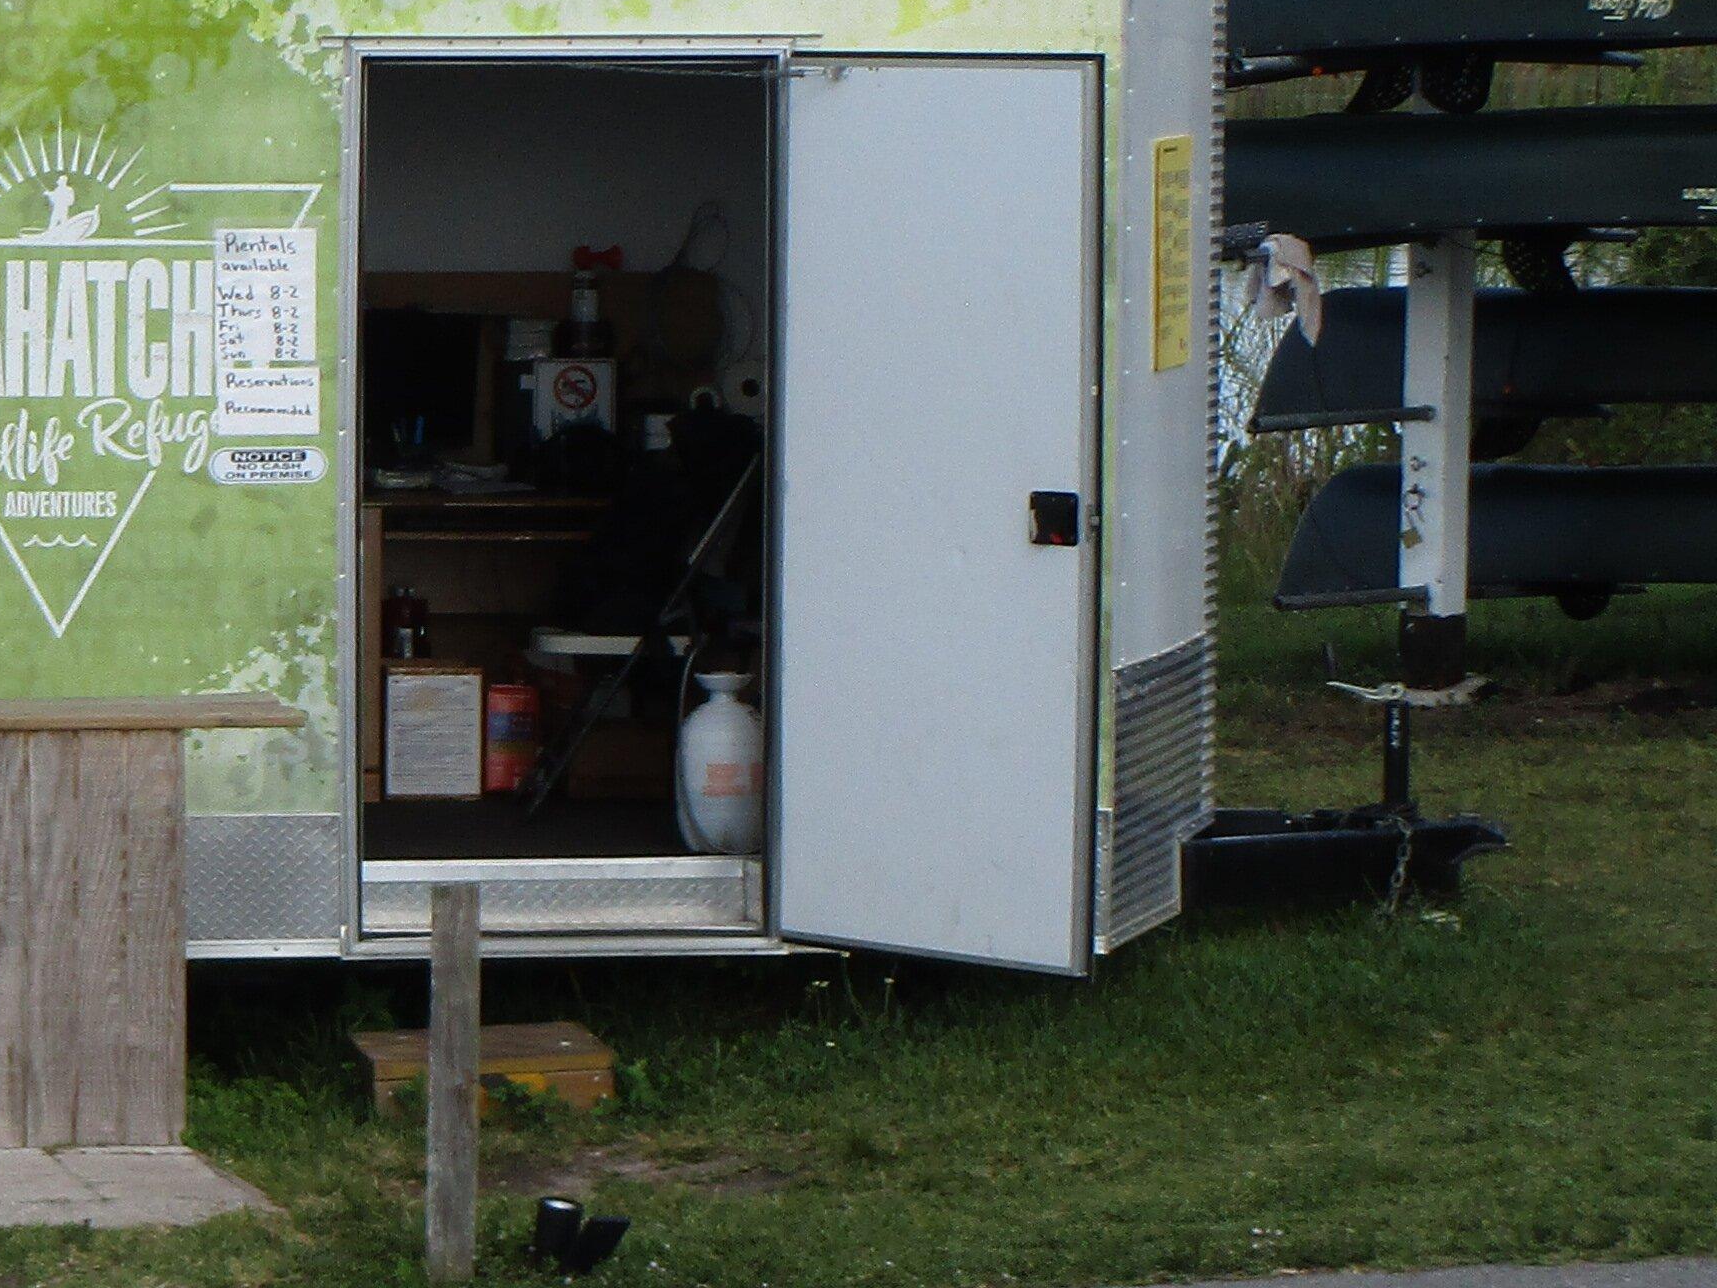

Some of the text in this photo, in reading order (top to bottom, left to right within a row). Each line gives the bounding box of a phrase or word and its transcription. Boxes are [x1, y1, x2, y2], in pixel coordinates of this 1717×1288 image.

[225, 233, 296, 255] Rentals
[221, 261, 289, 272] available
[218, 286, 299, 300] Wed 8-2
[218, 303, 300, 319] Thurs 8-2
[219, 320, 299, 334] Fri 8-2
[219, 333, 299, 346] Sat 8-2
[220, 347, 298, 359] Sun 8-2
[225, 372, 314, 389] Reservations
[234, 452, 306, 462] NOTICE
[260, 462, 302, 470] CASH
[225, 470, 313, 479] ON PREMISE
[4, 491, 117, 518] ADVENTURES
